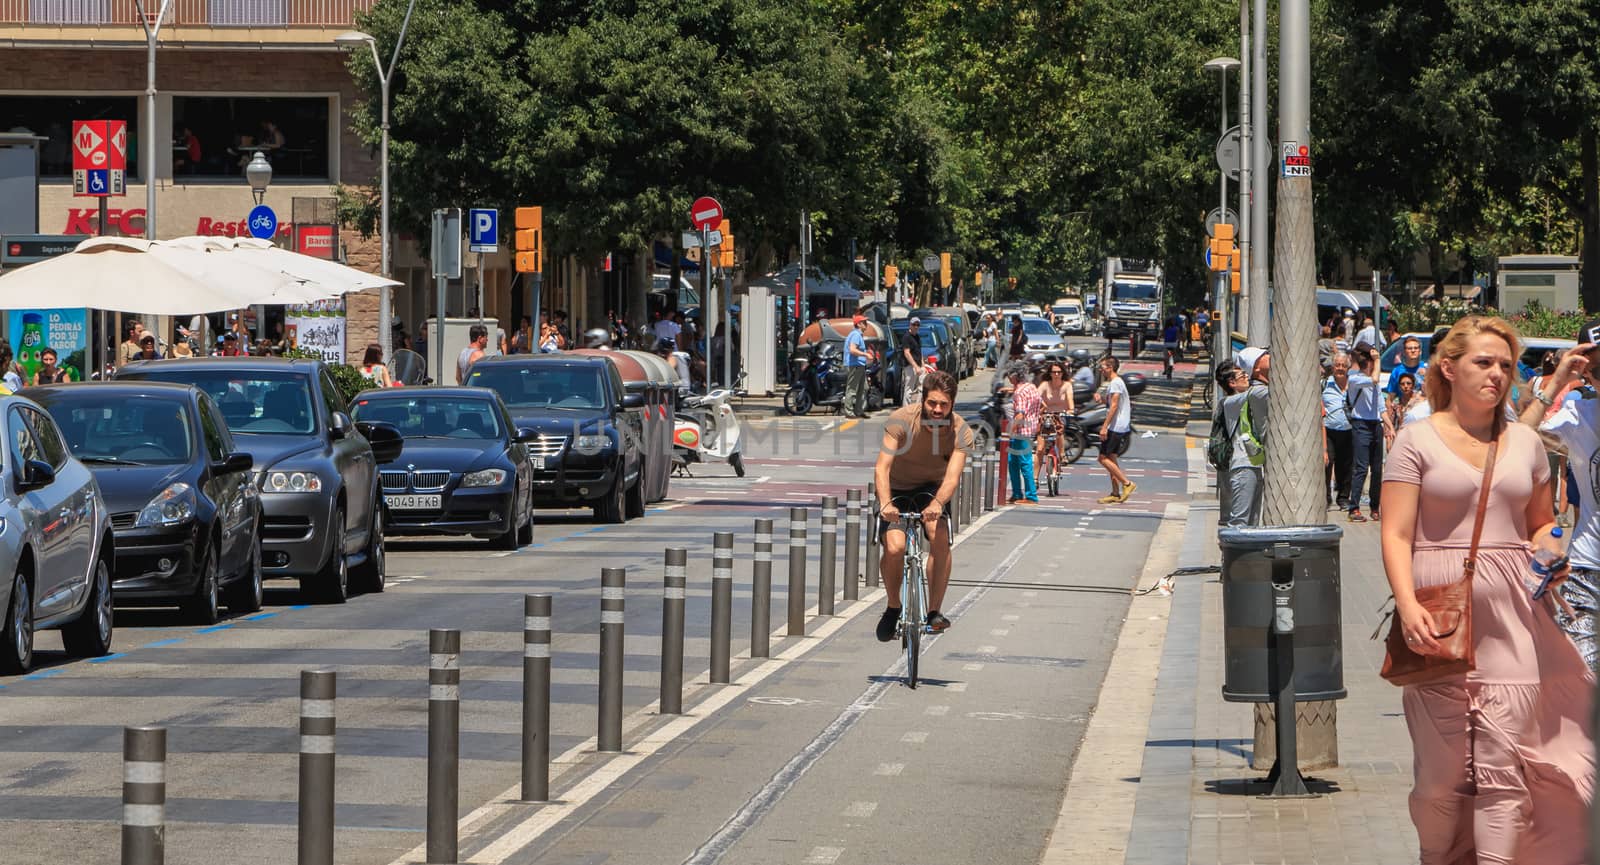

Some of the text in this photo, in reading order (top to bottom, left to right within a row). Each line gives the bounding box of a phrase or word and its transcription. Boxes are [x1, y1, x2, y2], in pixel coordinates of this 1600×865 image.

[80, 132, 92, 149] M
[63, 208, 146, 234] KFC
[475, 213, 492, 241] P
[49, 314, 60, 322] LO
[49, 331, 78, 340] POR SU
[49, 341, 76, 349] SABOR
[388, 496, 439, 508] 9049 FKB
